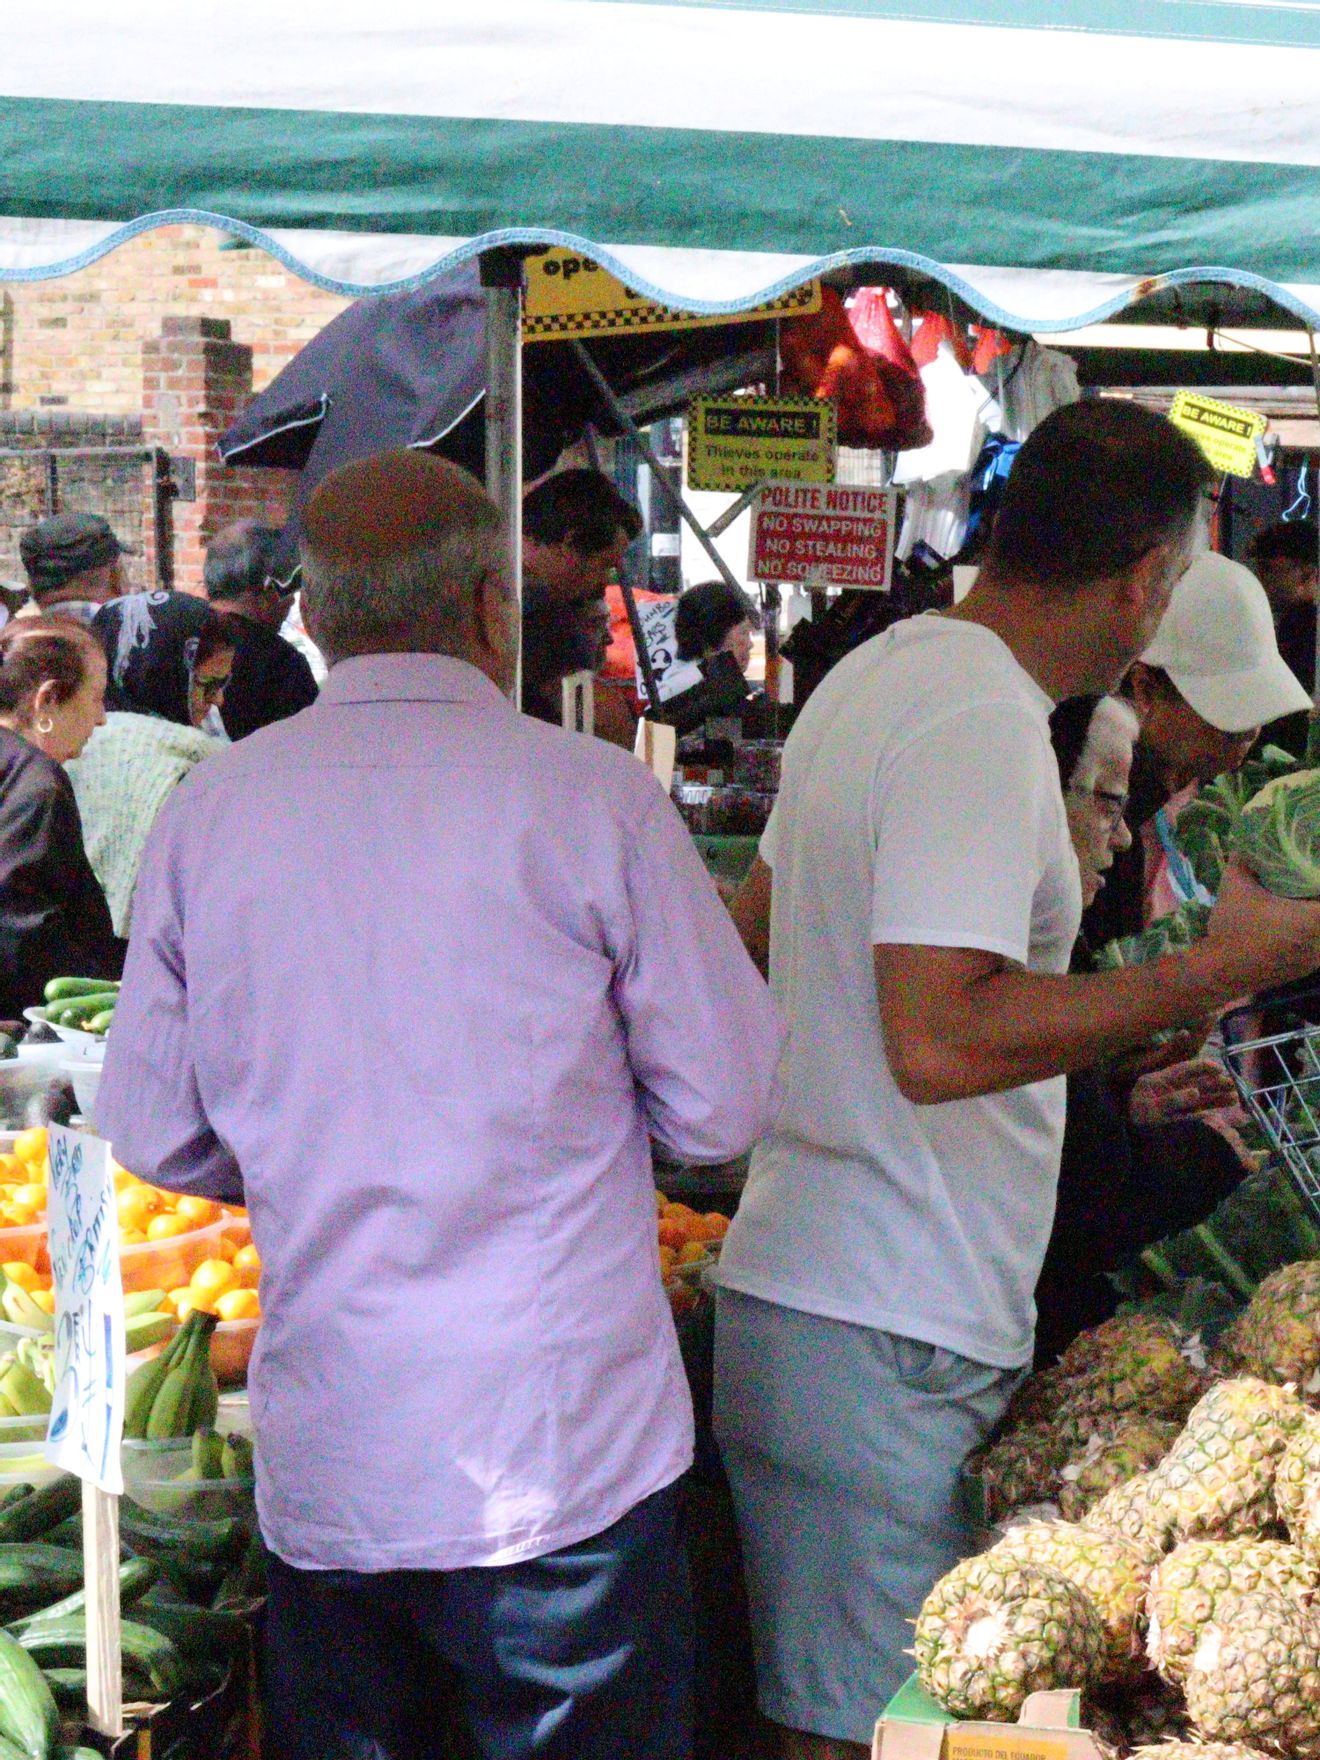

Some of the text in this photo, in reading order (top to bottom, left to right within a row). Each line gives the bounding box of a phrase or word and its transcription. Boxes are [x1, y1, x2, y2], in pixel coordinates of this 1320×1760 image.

[706, 415, 732, 430] BE
[739, 416, 808, 432] AWARE
[1182, 405, 1200, 418] BE
[1200, 411, 1246, 433] AWARE
[760, 486, 889, 515] POLITE NOTICE
[763, 515, 882, 537] NO SWAPPING
[766, 538, 877, 559] NO STEALING
[757, 559, 784, 575] NO
